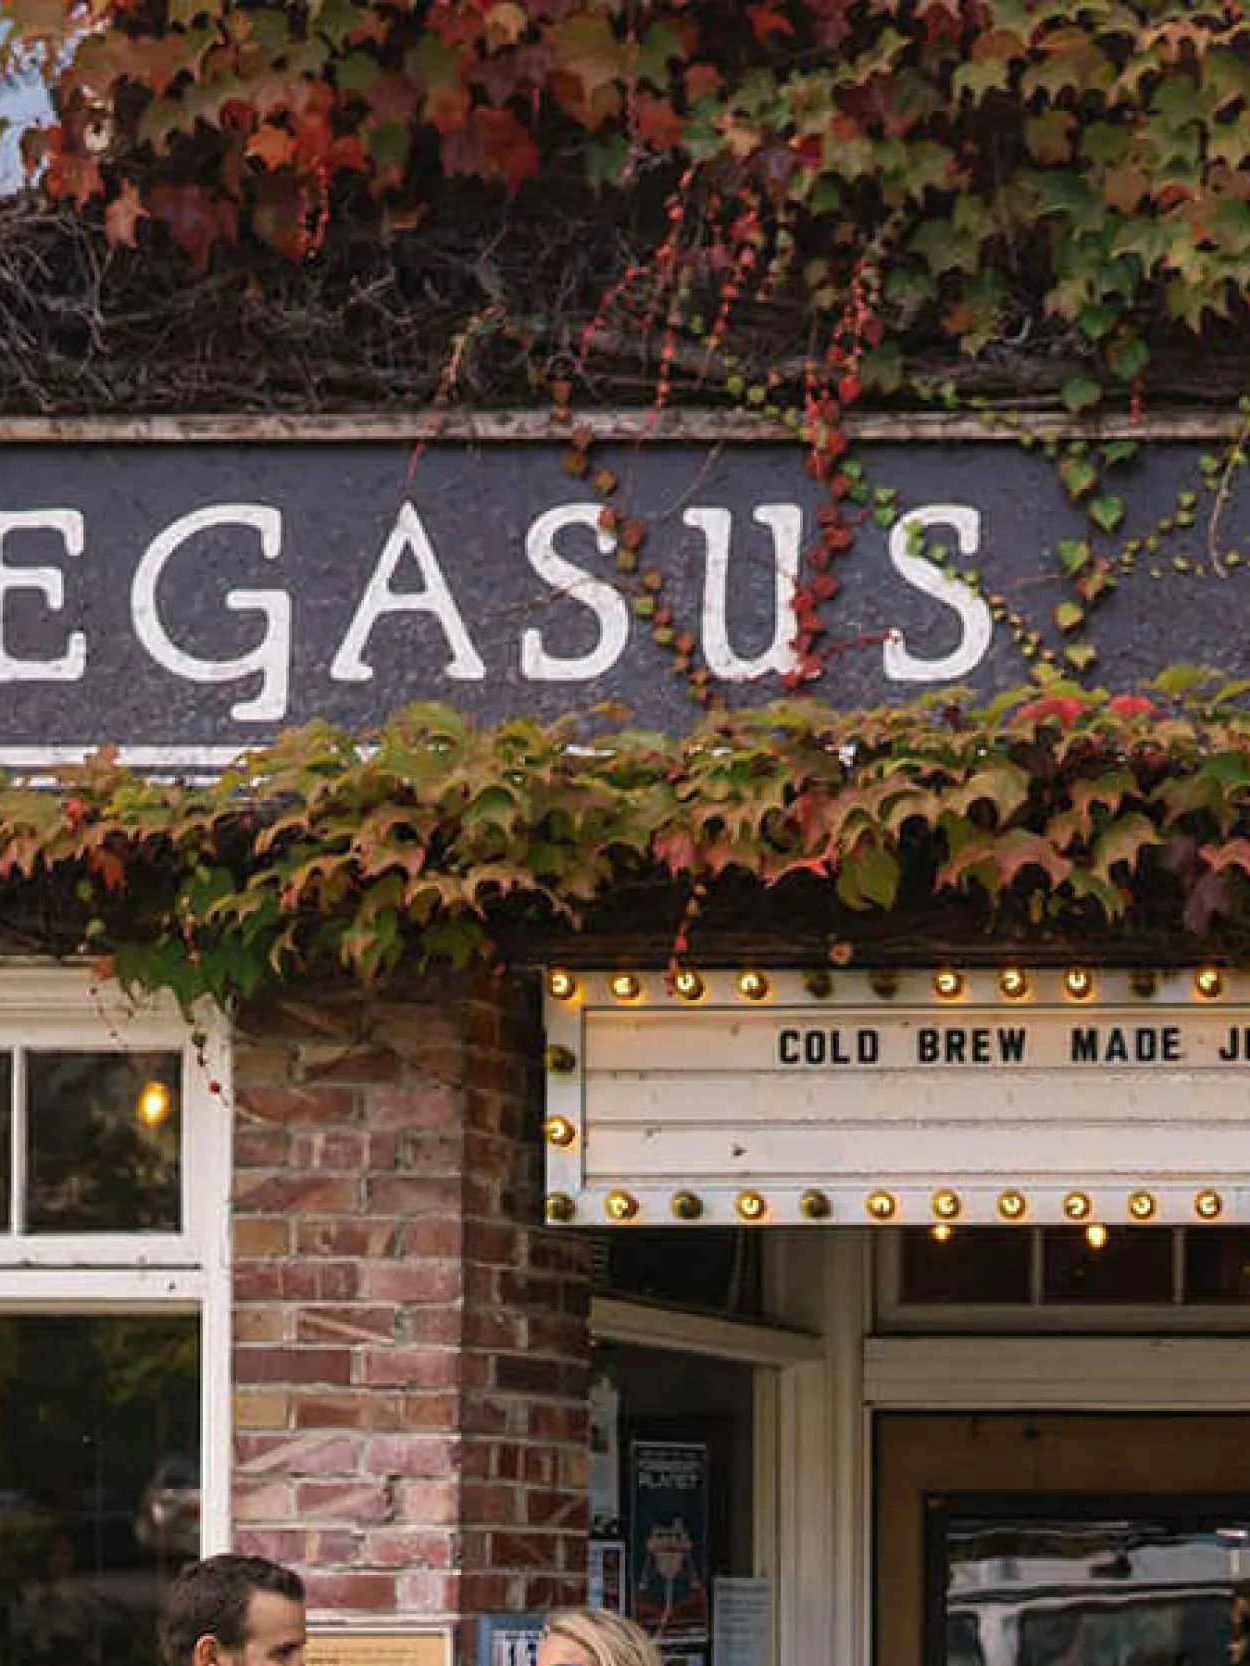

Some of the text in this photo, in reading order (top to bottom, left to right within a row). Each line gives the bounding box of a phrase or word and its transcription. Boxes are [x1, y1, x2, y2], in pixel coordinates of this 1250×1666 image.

[778, 1027, 1250, 1065] COLD BREW MADE J
